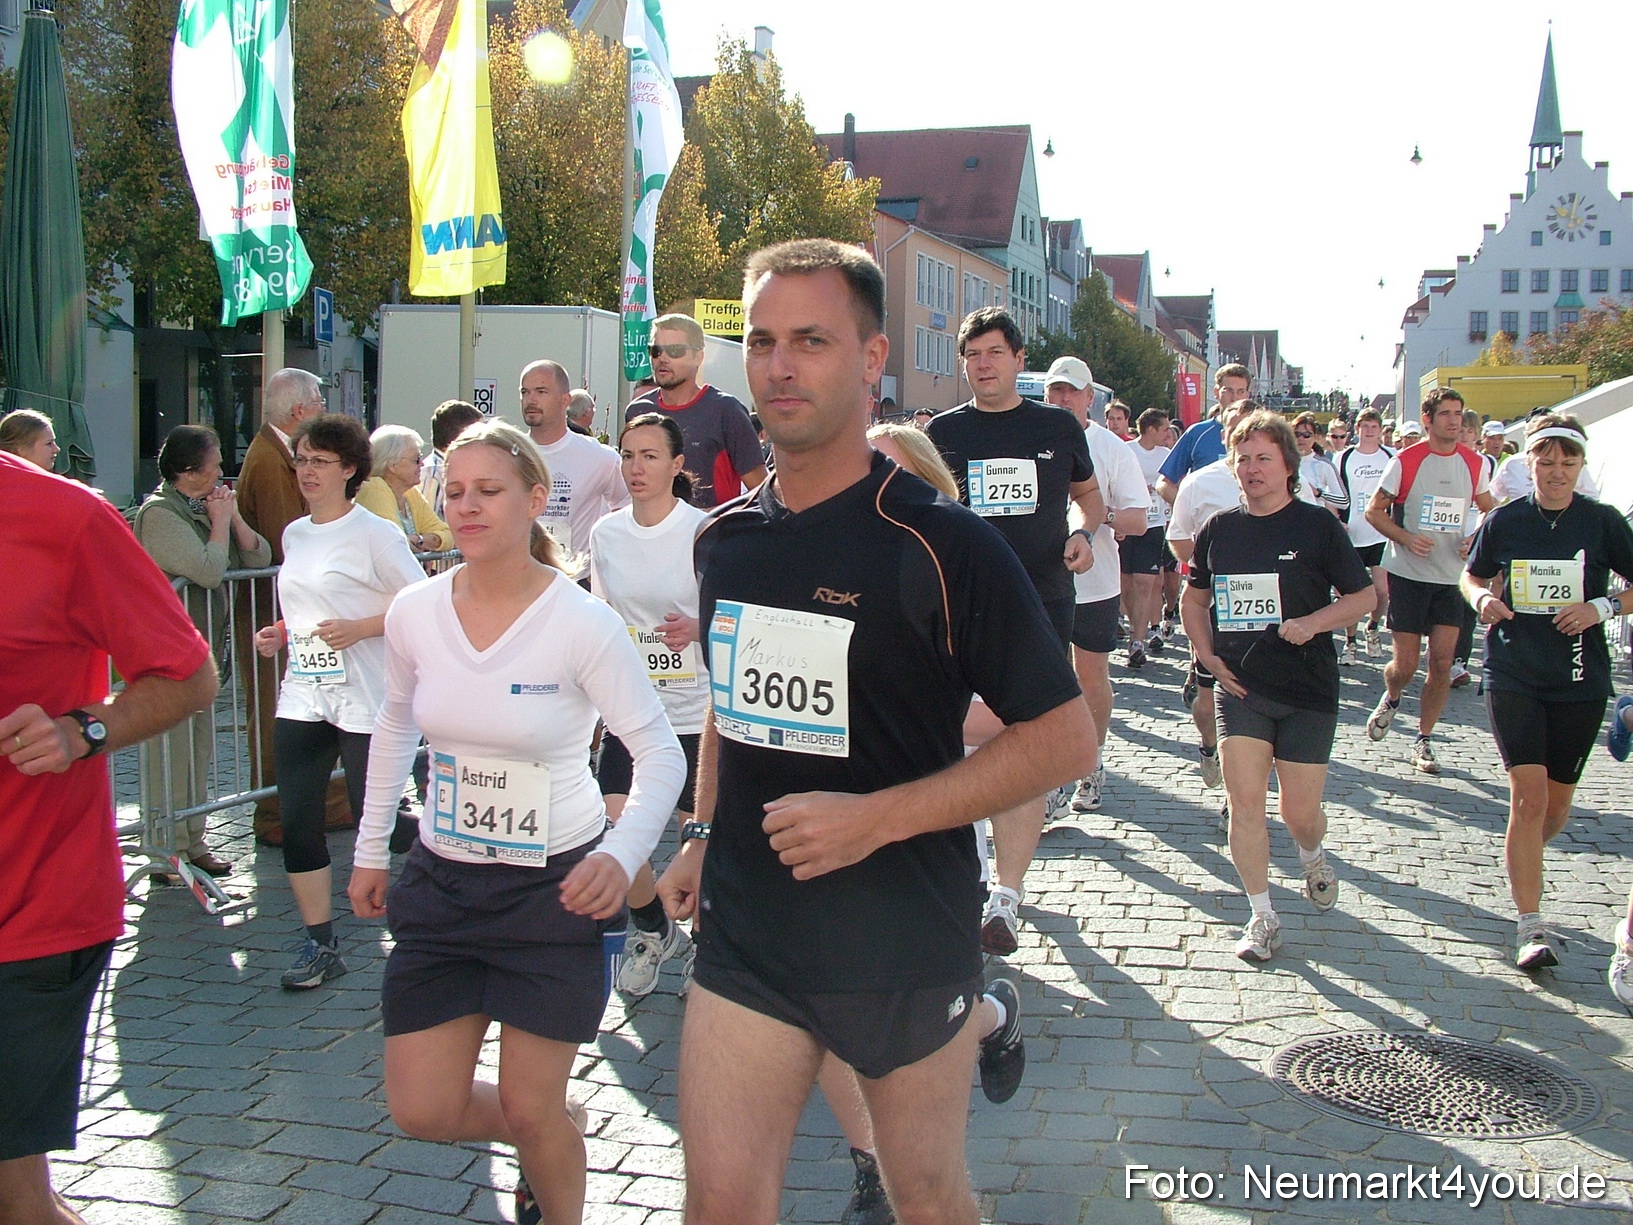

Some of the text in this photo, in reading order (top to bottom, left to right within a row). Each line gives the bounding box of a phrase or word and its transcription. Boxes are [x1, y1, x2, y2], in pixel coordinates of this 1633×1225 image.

[319, 295, 329, 334] P
[986, 464, 1019, 476] Gunnar
[988, 483, 1033, 500] 2755
[1433, 511, 1461, 524] 3016
[1530, 565, 1561, 576] Monika
[1229, 580, 1253, 592] Silvia
[1538, 585, 1572, 599] 728
[1233, 598, 1276, 616] 2756
[300, 651, 338, 669] 3455
[739, 636, 808, 669] Markus
[647, 652, 683, 671] 998
[742, 667, 835, 717] 3605
[785, 730, 846, 747] PFLEIDERER
[461, 765, 507, 790] Astrid
[463, 801, 539, 837] 3414
[498, 847, 545, 860] PFLEIDERER
